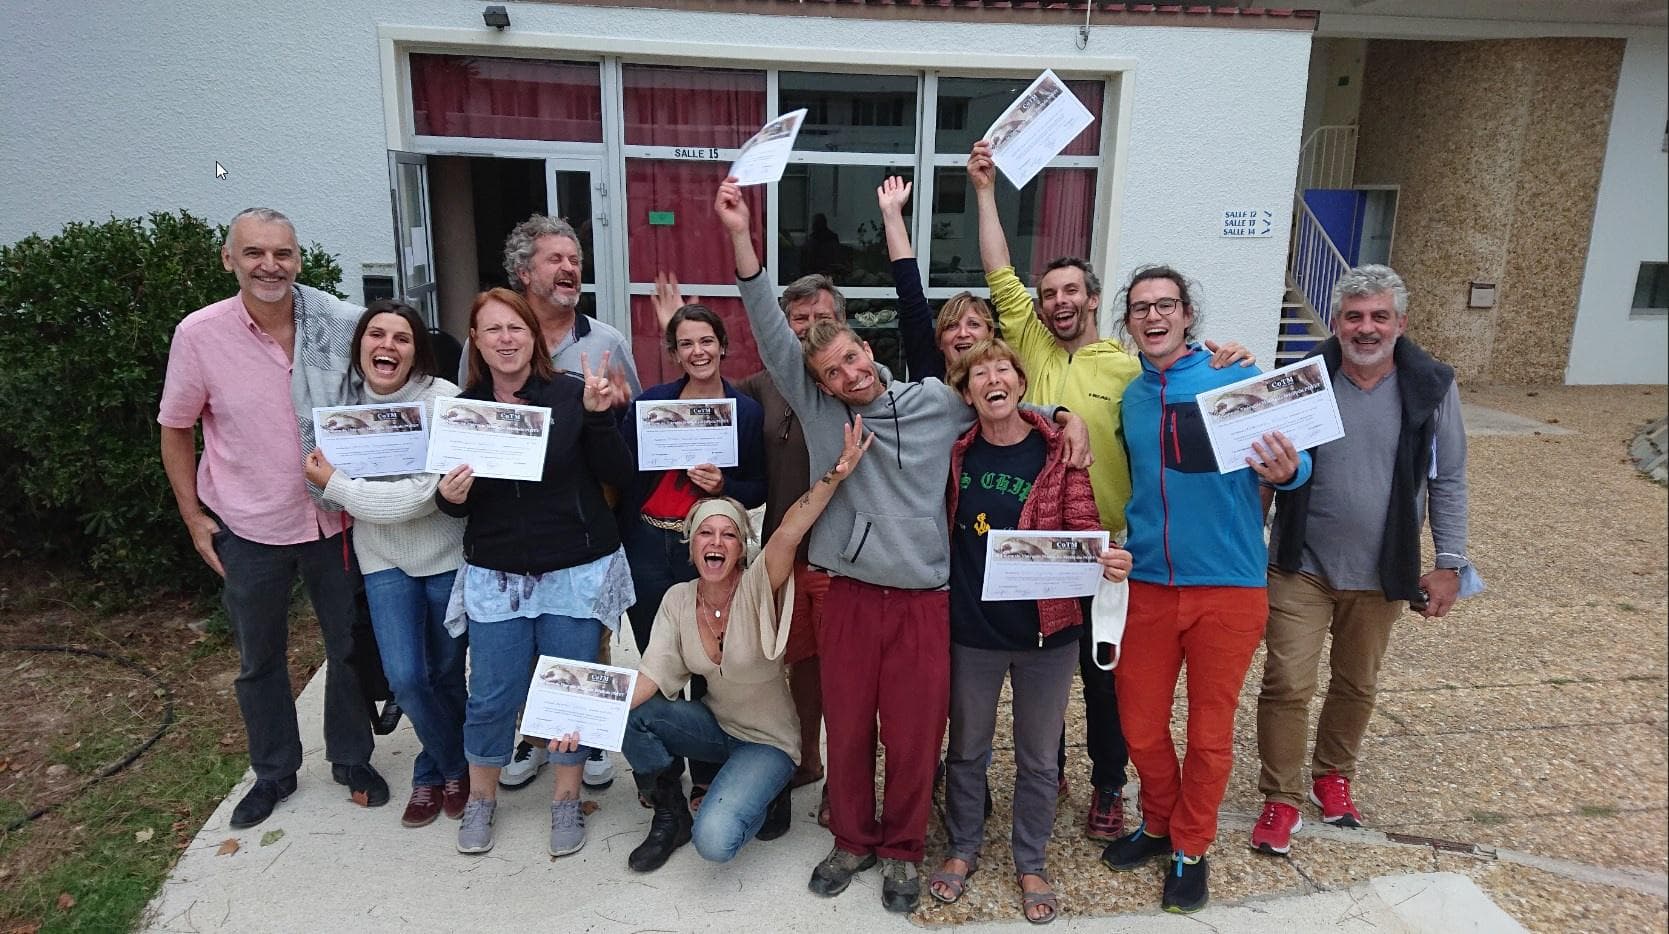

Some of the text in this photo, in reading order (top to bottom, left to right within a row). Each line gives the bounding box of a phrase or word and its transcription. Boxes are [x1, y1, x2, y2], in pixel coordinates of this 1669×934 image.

[674, 148, 719, 159] SALLE 15
[1271, 376, 1295, 388] CoTM
